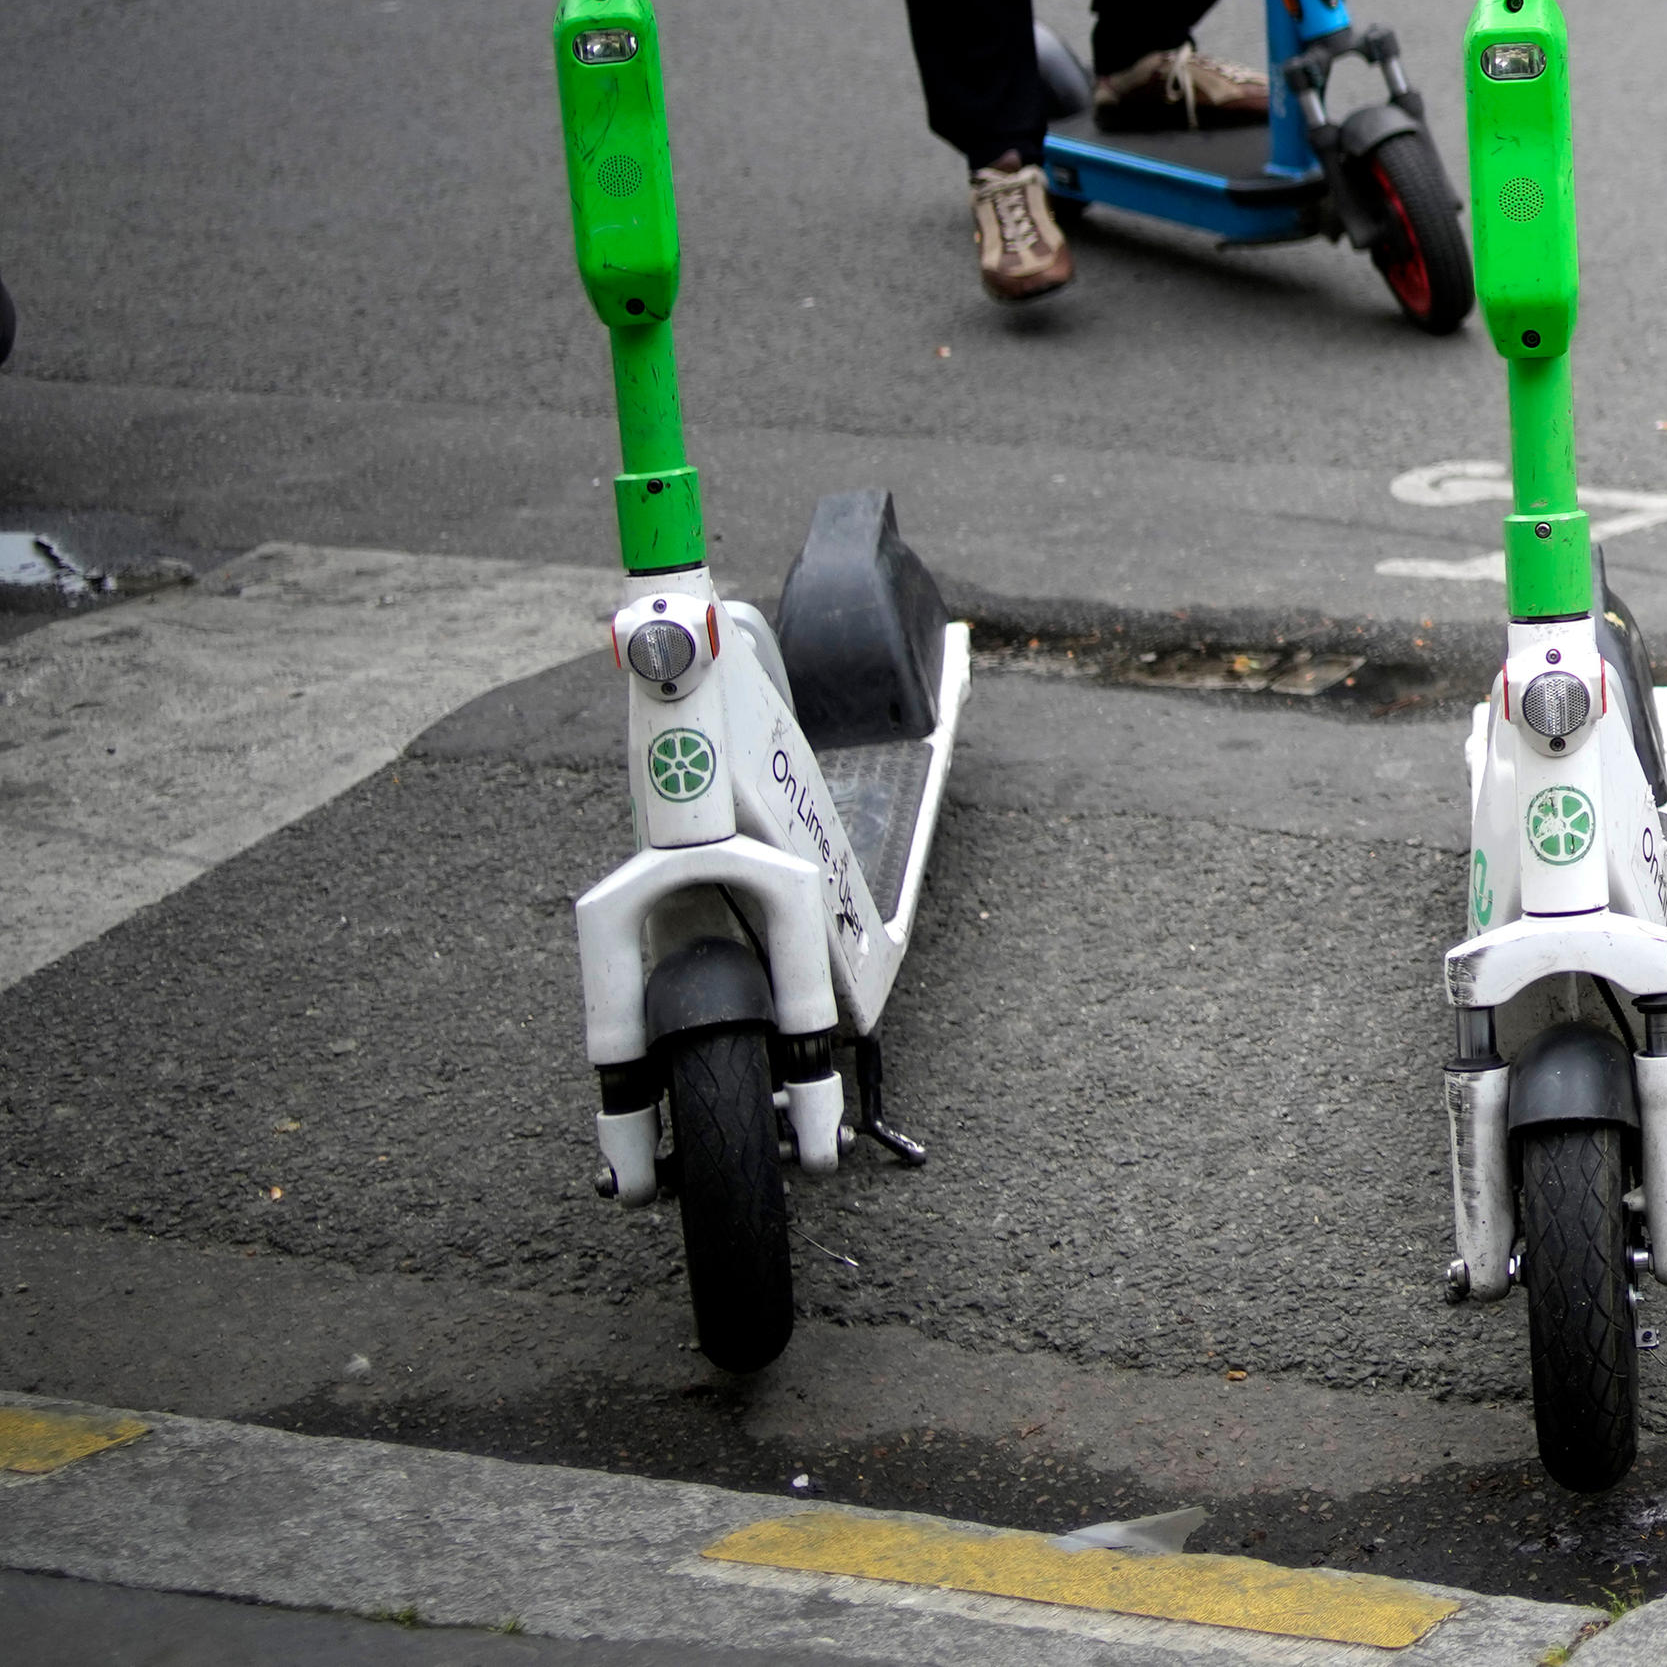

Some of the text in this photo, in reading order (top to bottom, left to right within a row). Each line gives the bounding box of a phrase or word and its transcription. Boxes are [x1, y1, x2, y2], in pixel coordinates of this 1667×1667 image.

[772, 749, 797, 804] On
[796, 787, 831, 864] Lime
[1642, 826, 1659, 885] On
